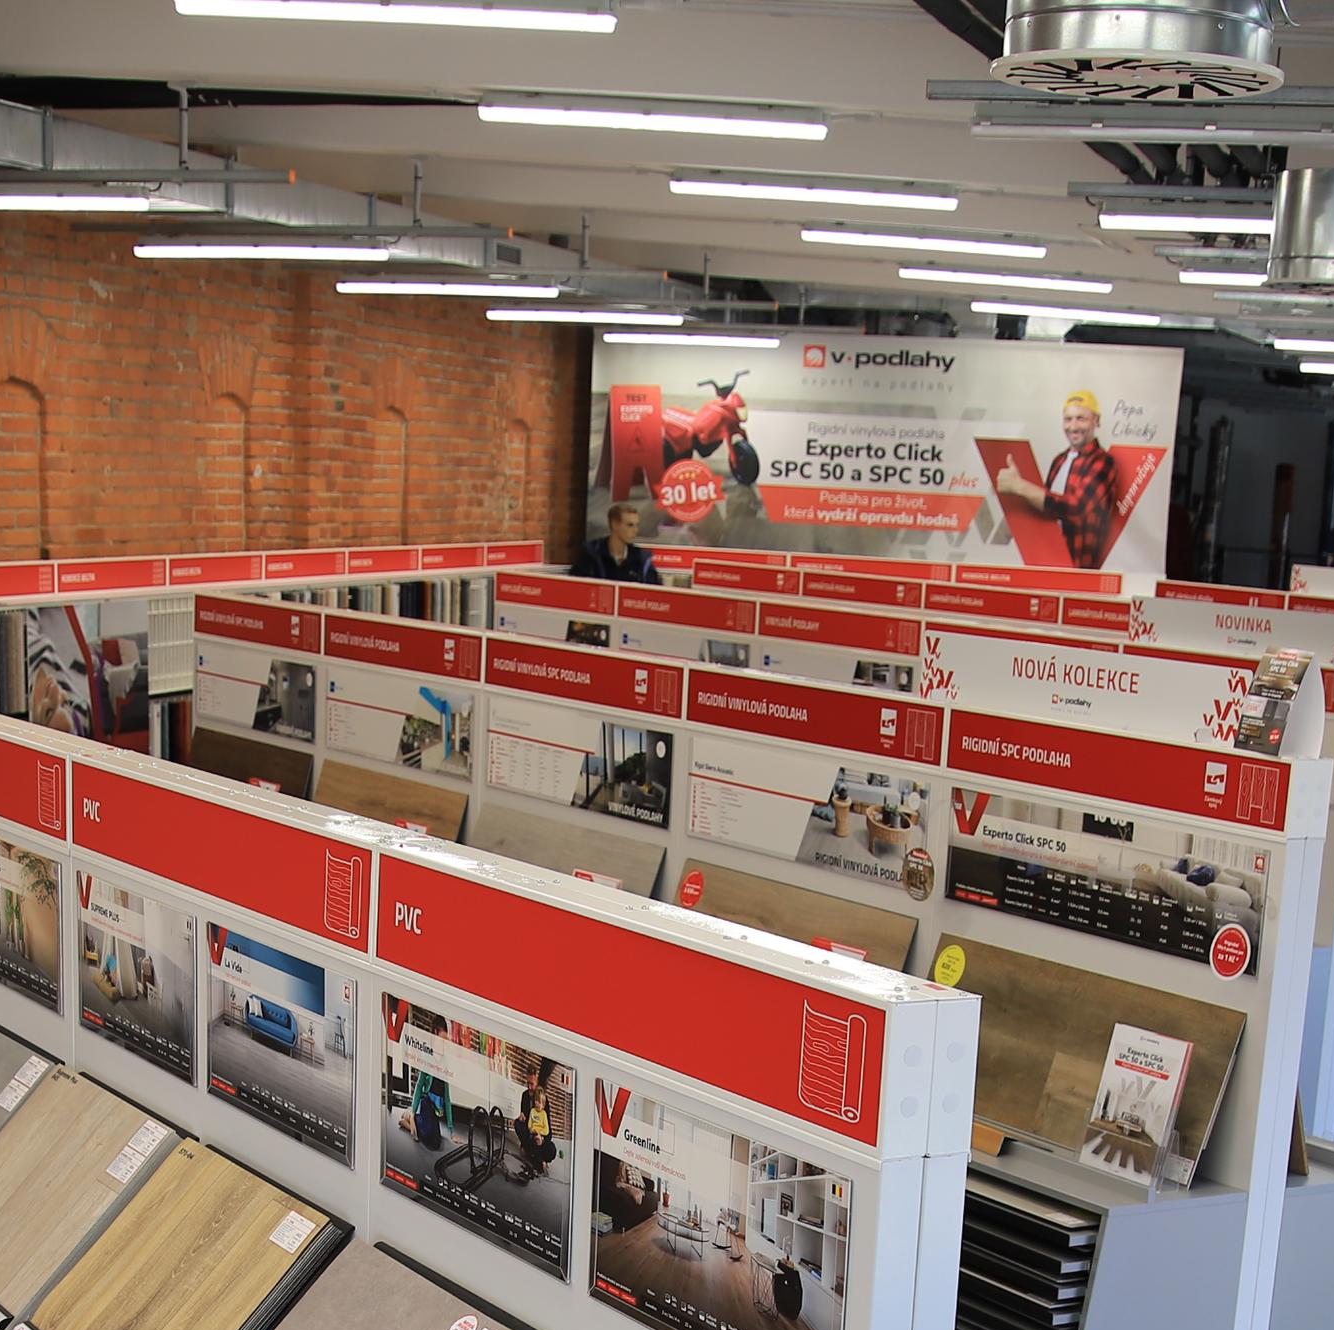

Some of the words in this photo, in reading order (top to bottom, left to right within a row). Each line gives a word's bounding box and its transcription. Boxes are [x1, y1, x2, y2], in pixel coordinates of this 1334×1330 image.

[806, 439, 886, 460] Experto
[893, 444, 943, 462] Click
[770, 461, 812, 479] SPC
[819, 463, 844, 480] 50
[851, 468, 862, 482] a
[869, 465, 912, 484] SPC
[919, 468, 945, 486] 50
[948, 472, 979, 491] plus
[661, 485, 686, 507] 30
[692, 481, 717, 501] let
[819, 491, 869, 506] Podlaha
[871, 497, 892, 509] pro
[1215, 614, 1272, 633] NOVINKA
[560, 670, 591, 684] PODLAHA
[1012, 656, 1057, 683] NOVÁ
[1063, 664, 1140, 694] KOLEKCE
[698, 691, 727, 708] RIGIDNÍ
[727, 696, 767, 715] VINYLOVÁ
[768, 705, 808, 722] PODLAHA
[962, 736, 1001, 755] RIGIDNÍ
[1001, 742, 1021, 759] SPC
[1022, 746, 1071, 768] PODLAHA
[83, 797, 101, 823] PVC
[982, 825, 1013, 843] Experto
[1015, 832, 1035, 847] Click
[1037, 836, 1053, 850] SPC
[1056, 840, 1066, 853] 50
[815, 851, 842, 869] RIGIDNÍ
[843, 859, 878, 876] VINYLOVÁ
[395, 900, 422, 935] PVC
[224, 958, 231, 968] La
[231, 961, 242, 974] Vida
[404, 1033, 434, 1056] Whiteline
[624, 1129, 660, 1155] Greenline
